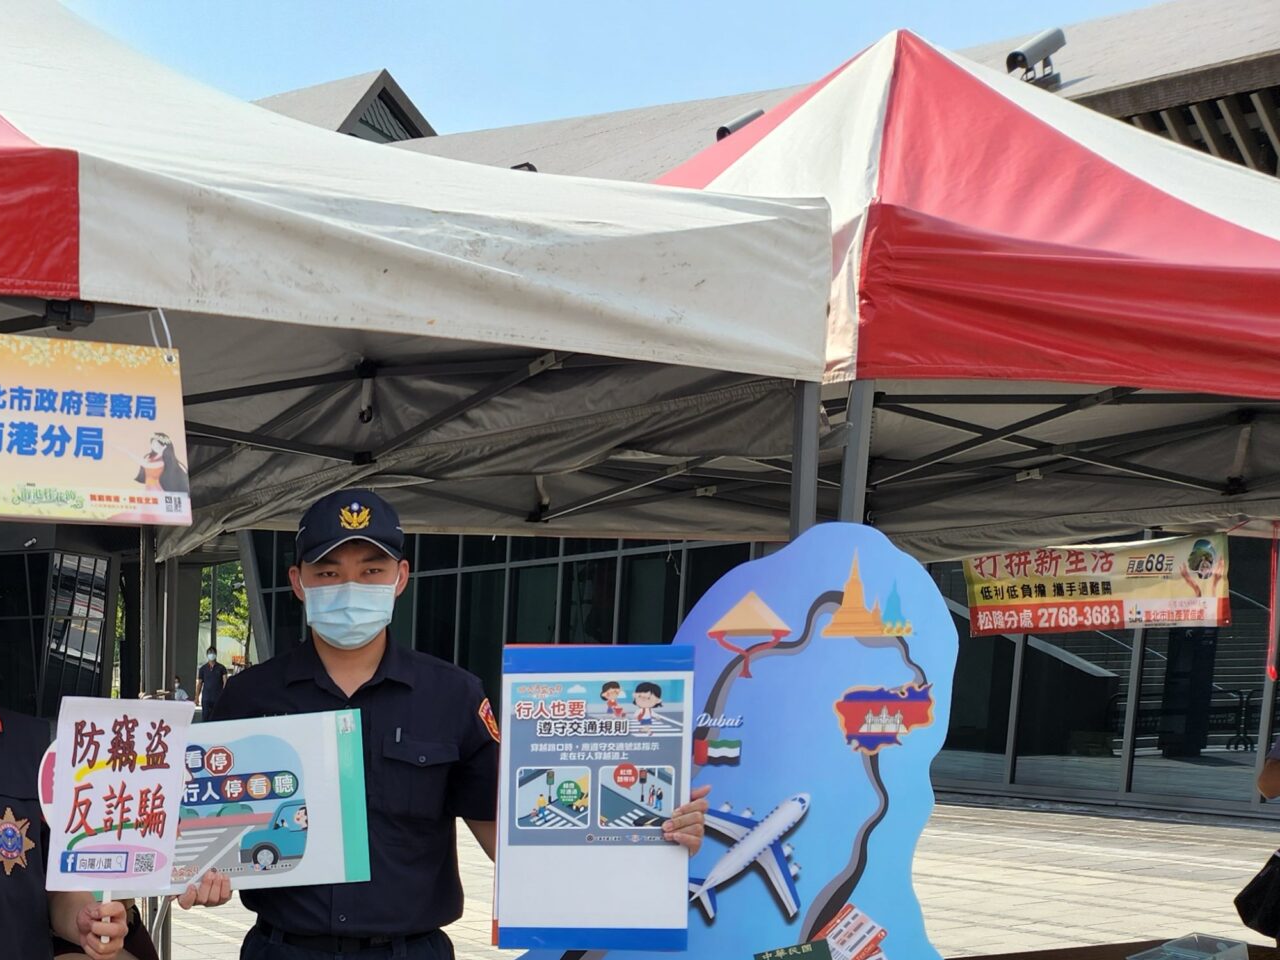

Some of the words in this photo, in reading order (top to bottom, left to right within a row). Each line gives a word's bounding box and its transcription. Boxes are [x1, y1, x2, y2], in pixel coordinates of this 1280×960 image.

[980, 583, 1047, 602] 低利低負擔
[1053, 580, 1112, 597] 攜手過難關
[977, 608, 1033, 631] 松隆分處
[1037, 604, 1120, 628] 2768-3683
[515, 701, 585, 719] 行人也要
[696, 712, 743, 728] Dubai
[538, 720, 628, 736] 遵守交通規則
[71, 714, 172, 773] 防竊盜
[65, 780, 167, 841] 反詐騙
